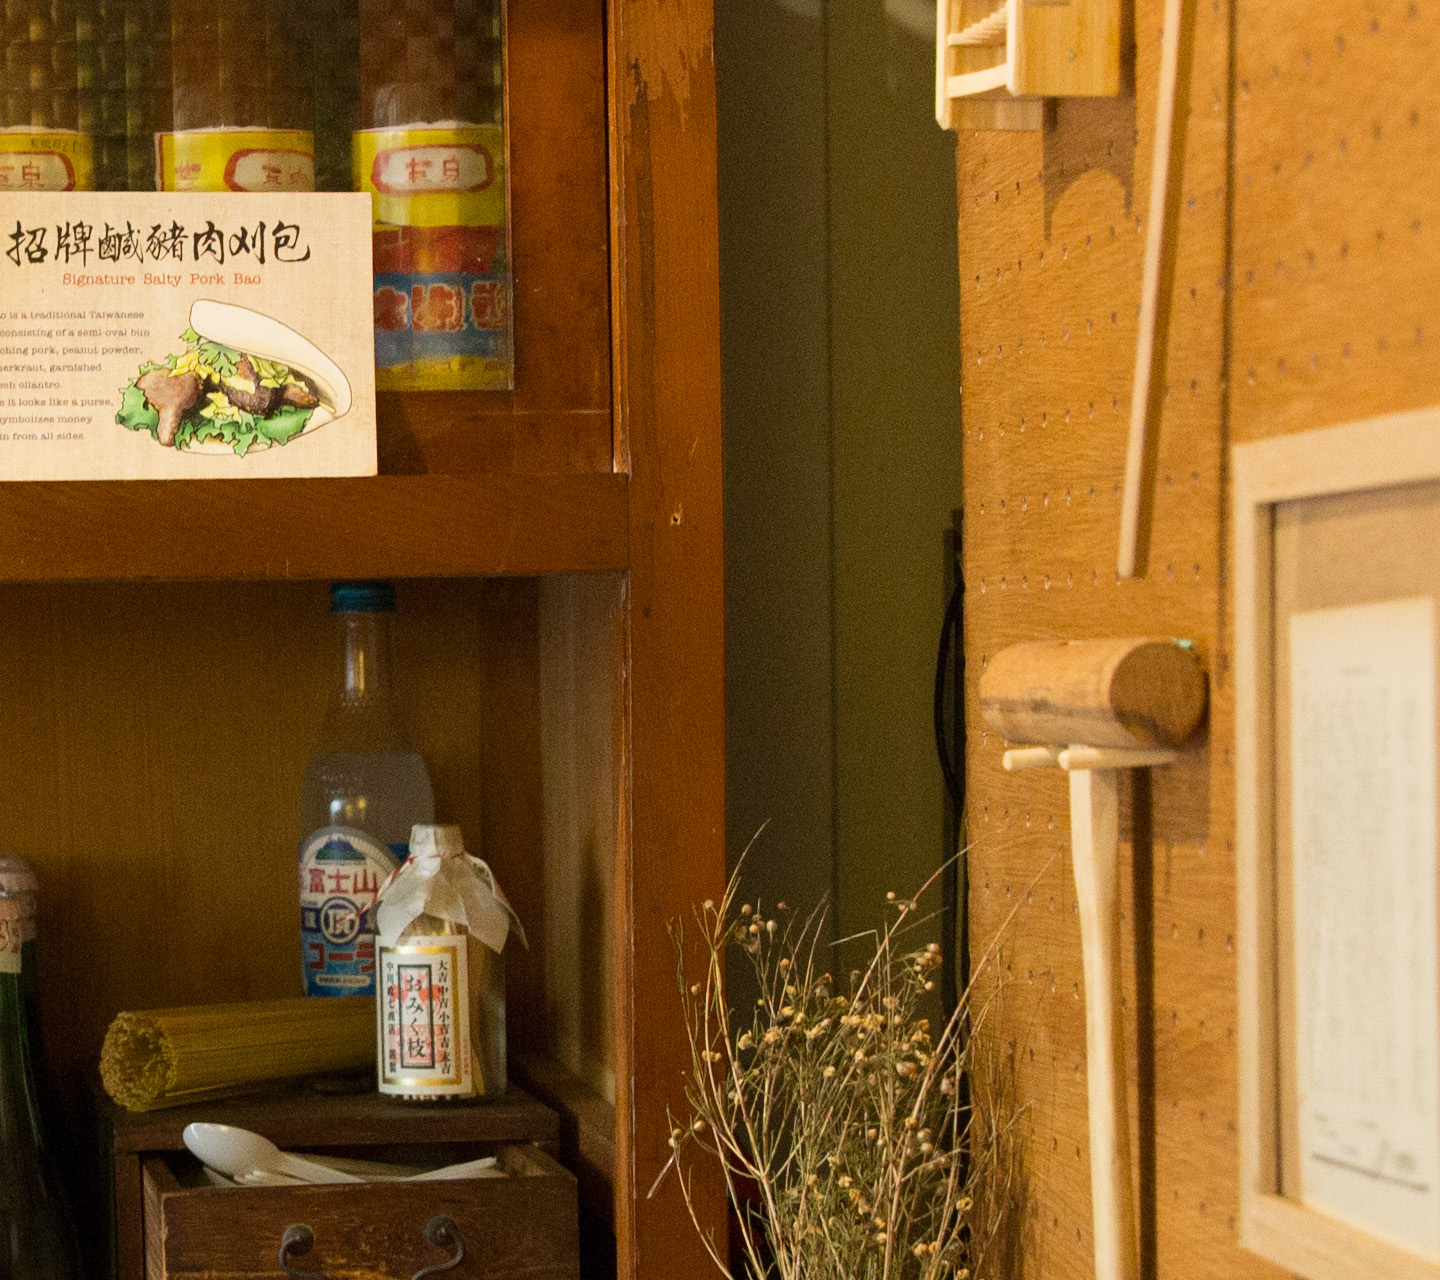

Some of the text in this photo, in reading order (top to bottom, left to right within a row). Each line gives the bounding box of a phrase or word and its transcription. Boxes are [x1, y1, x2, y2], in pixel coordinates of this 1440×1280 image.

[62, 273, 261, 286] Signature Salty Pork Bao
[9, 311, 18, 319] is
[30, 311, 86, 319] traditional
[89, 311, 144, 319] Taiwanese
[0, 329, 53, 338] consisting
[77, 329, 127, 337] semi-oval
[31, 347, 59, 356] pork,
[62, 347, 98, 356] peanut
[101, 347, 143, 355] powder,
[49, 363, 102, 373] garnished
[19, 381, 63, 389] cilantro.
[19, 398, 46, 406] looks
[49, 398, 69, 406] like
[58, 416, 93, 425] money
[57, 433, 86, 441] sides.
[309, 868, 379, 894] 富士山
